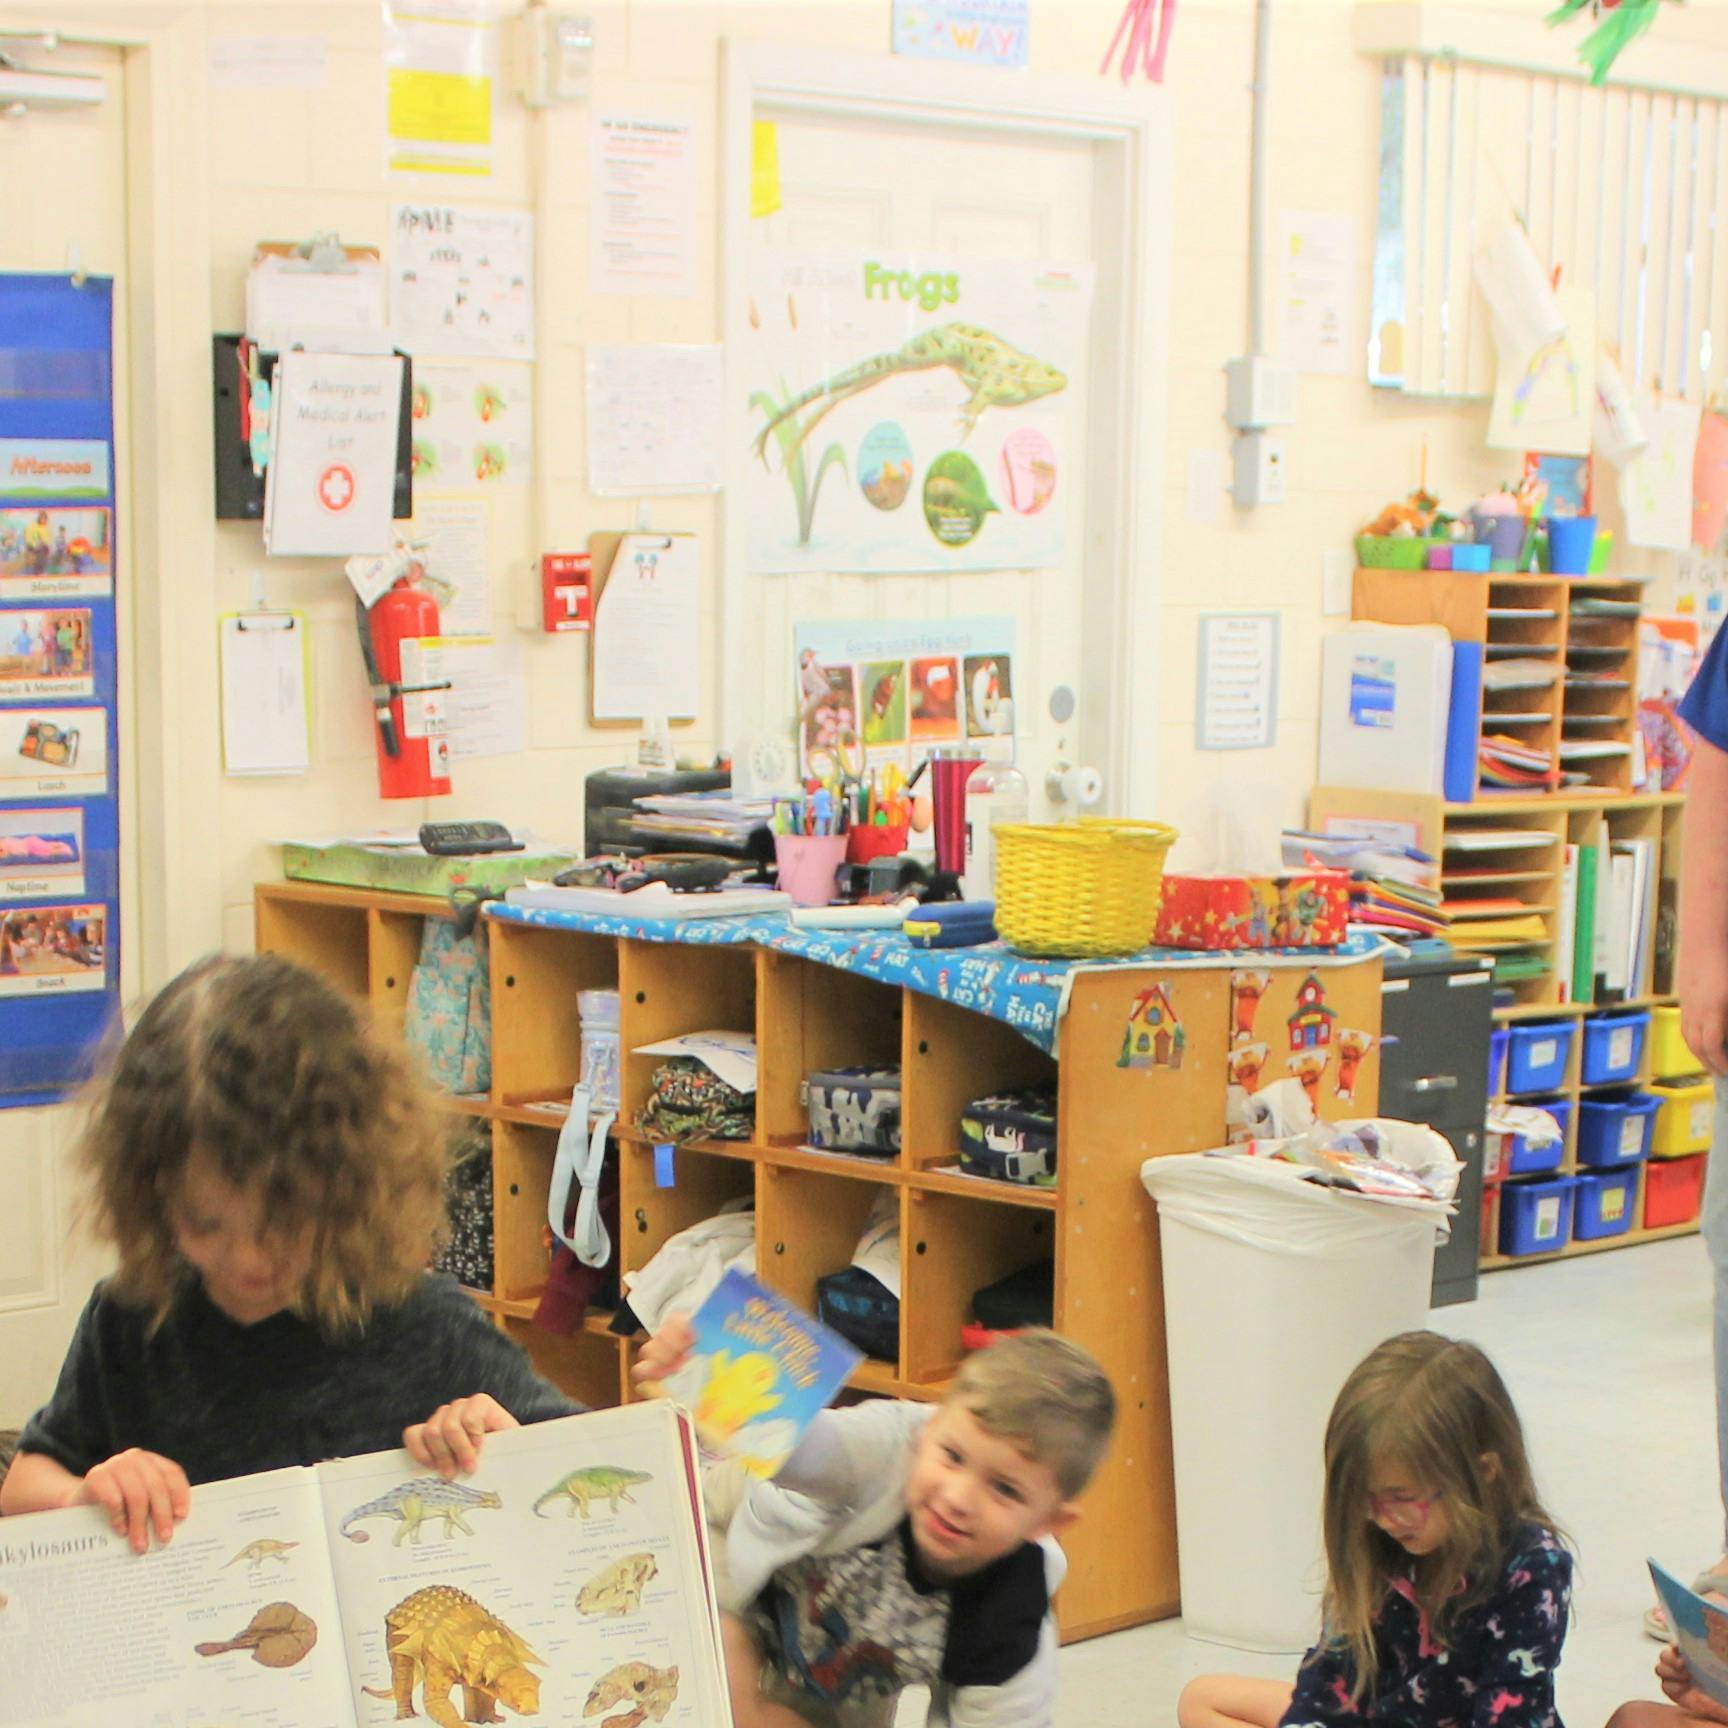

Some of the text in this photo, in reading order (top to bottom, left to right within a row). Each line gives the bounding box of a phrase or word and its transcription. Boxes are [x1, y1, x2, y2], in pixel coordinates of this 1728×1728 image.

[863, 261, 961, 312] Frogs
[309, 377, 355, 396] Allergy
[298, 406, 385, 421] Medical Alert
[9, 455, 91, 475] Afternoon
